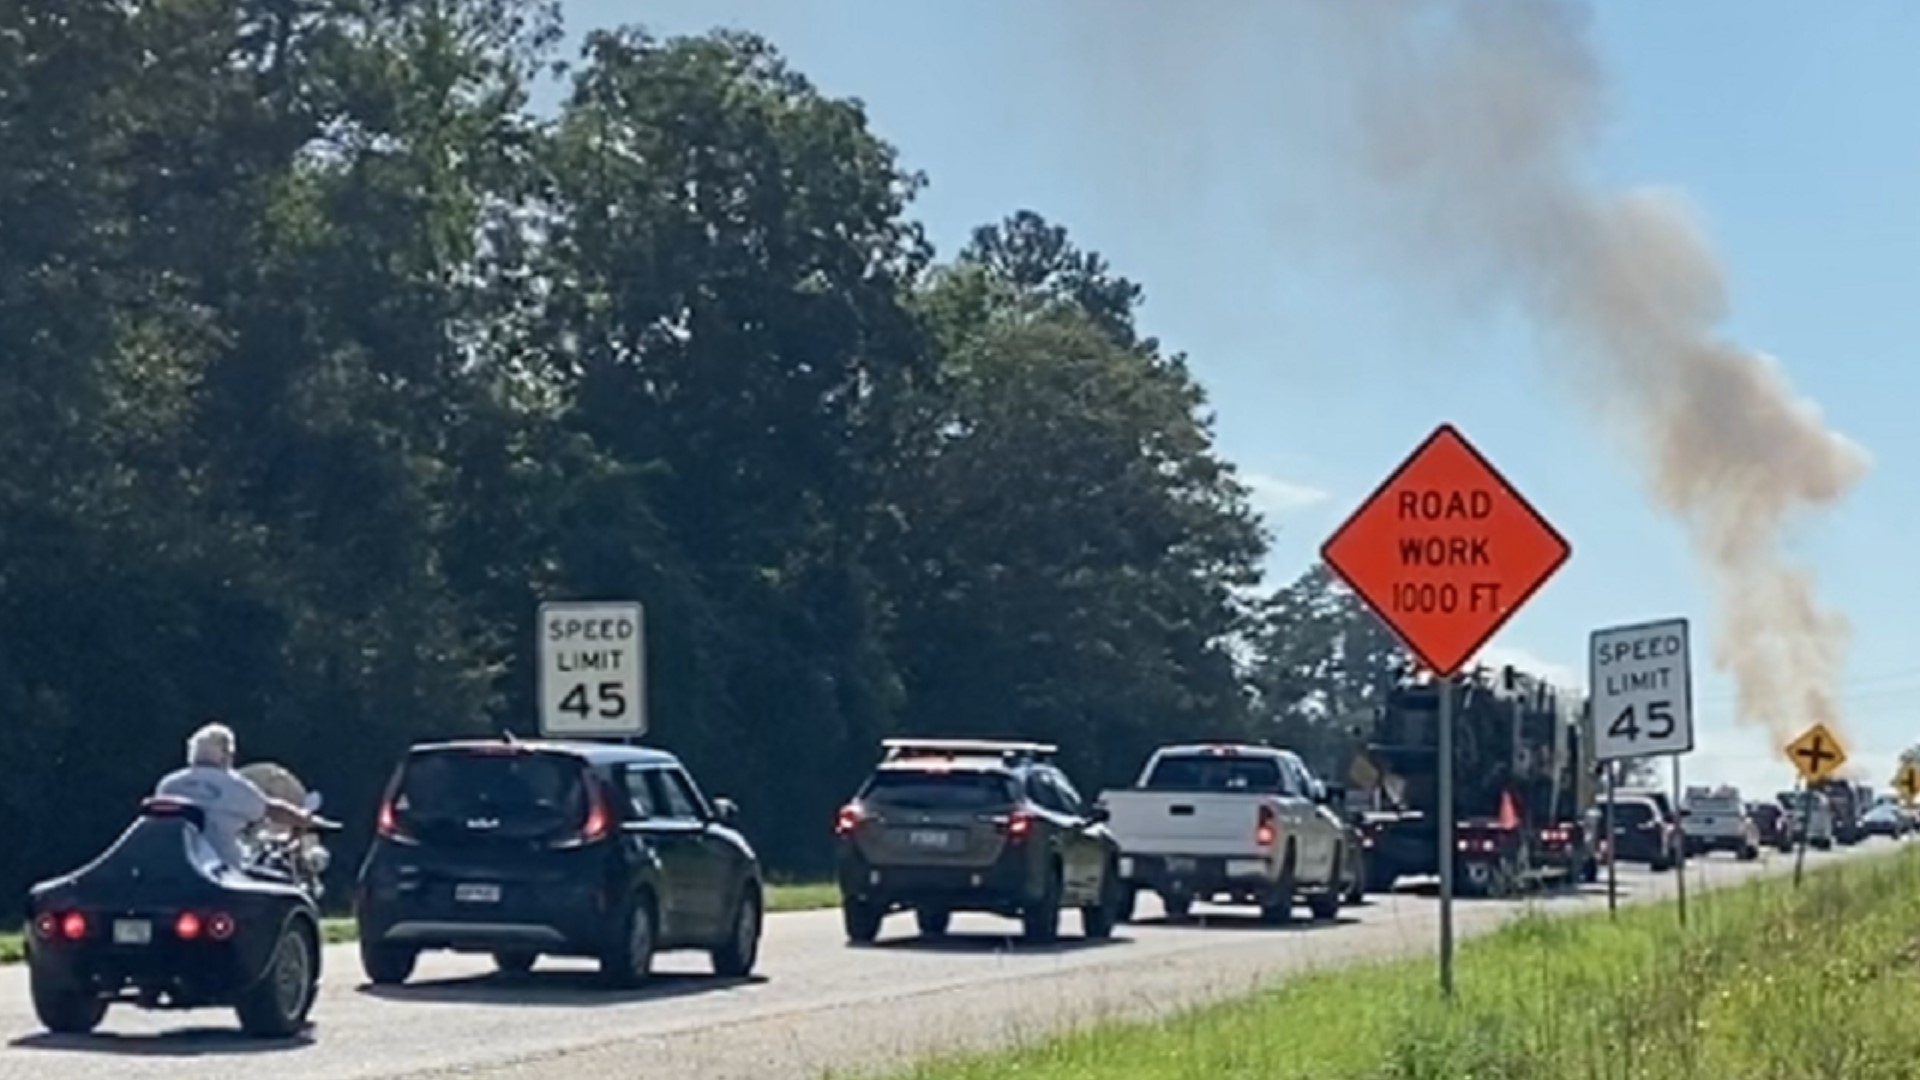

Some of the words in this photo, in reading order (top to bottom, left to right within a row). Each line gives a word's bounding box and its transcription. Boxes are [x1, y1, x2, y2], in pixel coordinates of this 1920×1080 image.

[1398, 490, 1492, 520] ROAD
[1399, 536, 1490, 567] WORK
[1392, 583, 1458, 613] 1000
[1470, 583, 1502, 613] FT
[549, 619, 633, 641] SPEED
[557, 649, 624, 672] LIMIT
[1598, 634, 1681, 666] SPEED
[1606, 666, 1671, 697] LIMIT
[557, 682, 626, 720] 45
[1607, 701, 1676, 743] 45
